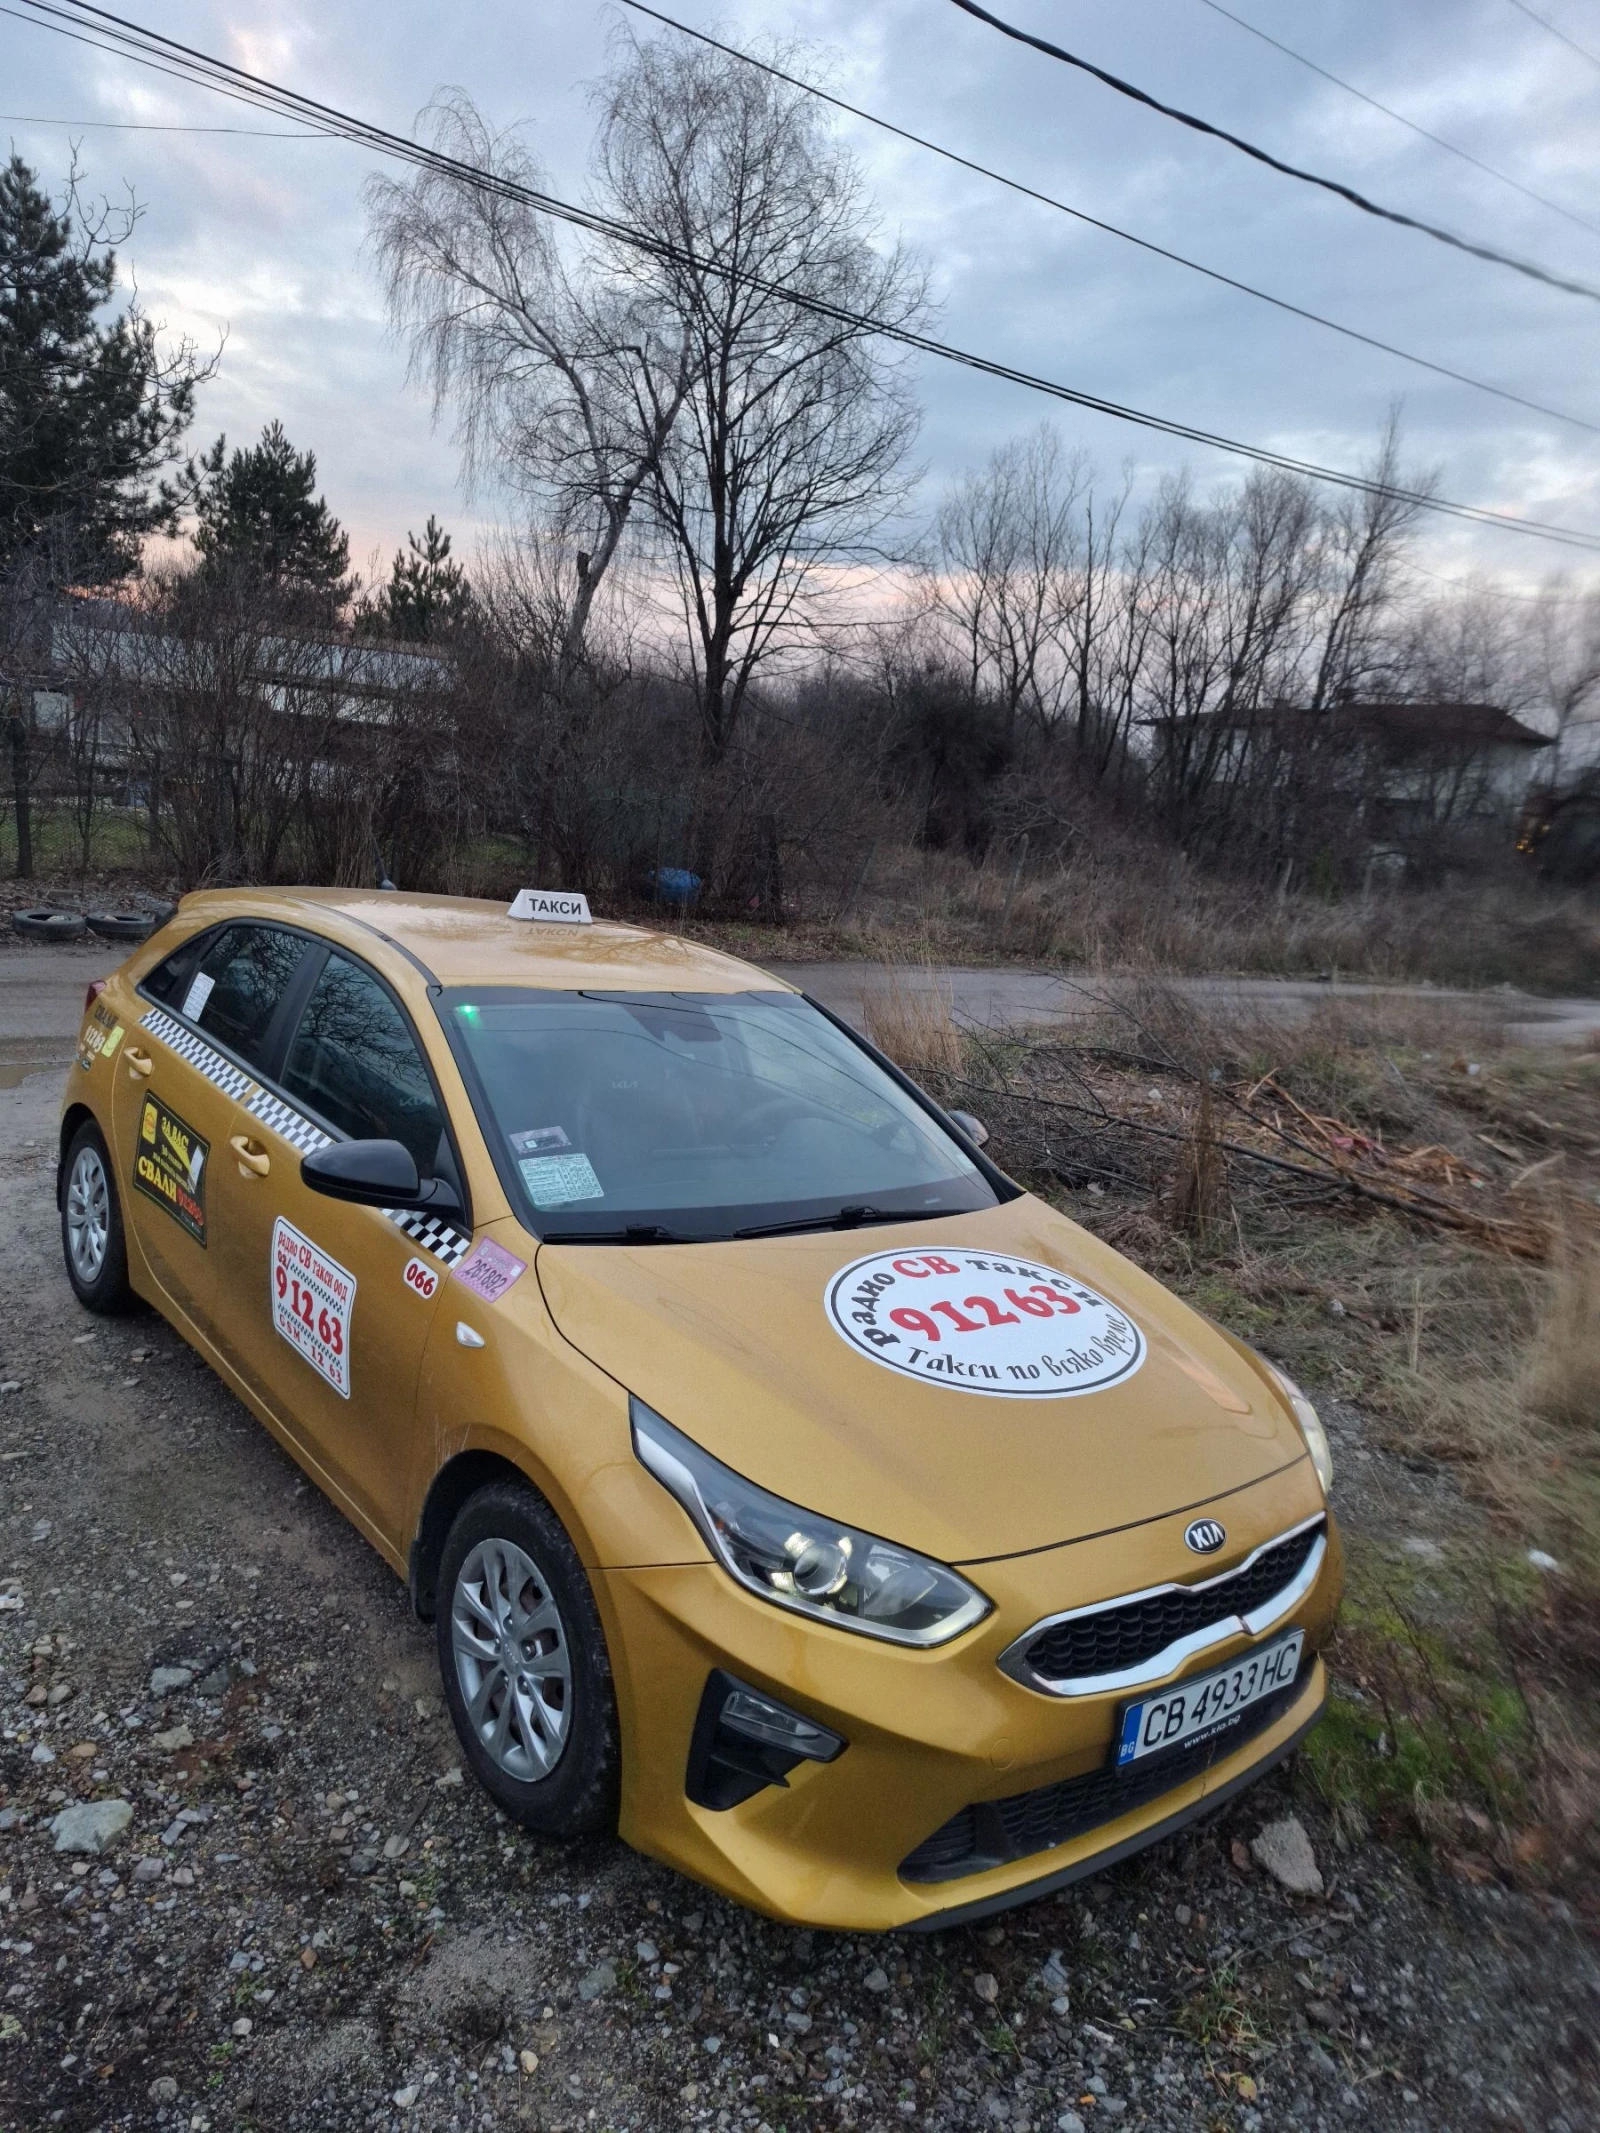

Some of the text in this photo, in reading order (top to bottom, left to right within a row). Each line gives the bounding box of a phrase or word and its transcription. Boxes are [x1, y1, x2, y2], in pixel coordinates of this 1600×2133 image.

[529, 898, 582, 915] ТАКСИ
[278, 1231, 348, 1305] радио СВ такси оод
[406, 1263, 435, 1296] 066
[464, 1258, 508, 1294] 261892
[851, 1255, 1104, 1347] радио СВ такси
[889, 1285, 1082, 1342] 91263
[279, 1314, 301, 1343] GSM
[311, 1346, 324, 1367] 12
[329, 1365, 342, 1384] 63
[907, 1314, 1135, 1380] Такси по всяко време
[1190, 1522, 1225, 1549] KIA
[1191, 1662, 1258, 1725] 4933
[1120, 1741, 1136, 1758] BG
[1184, 1714, 1241, 1749] www.kia.bg
